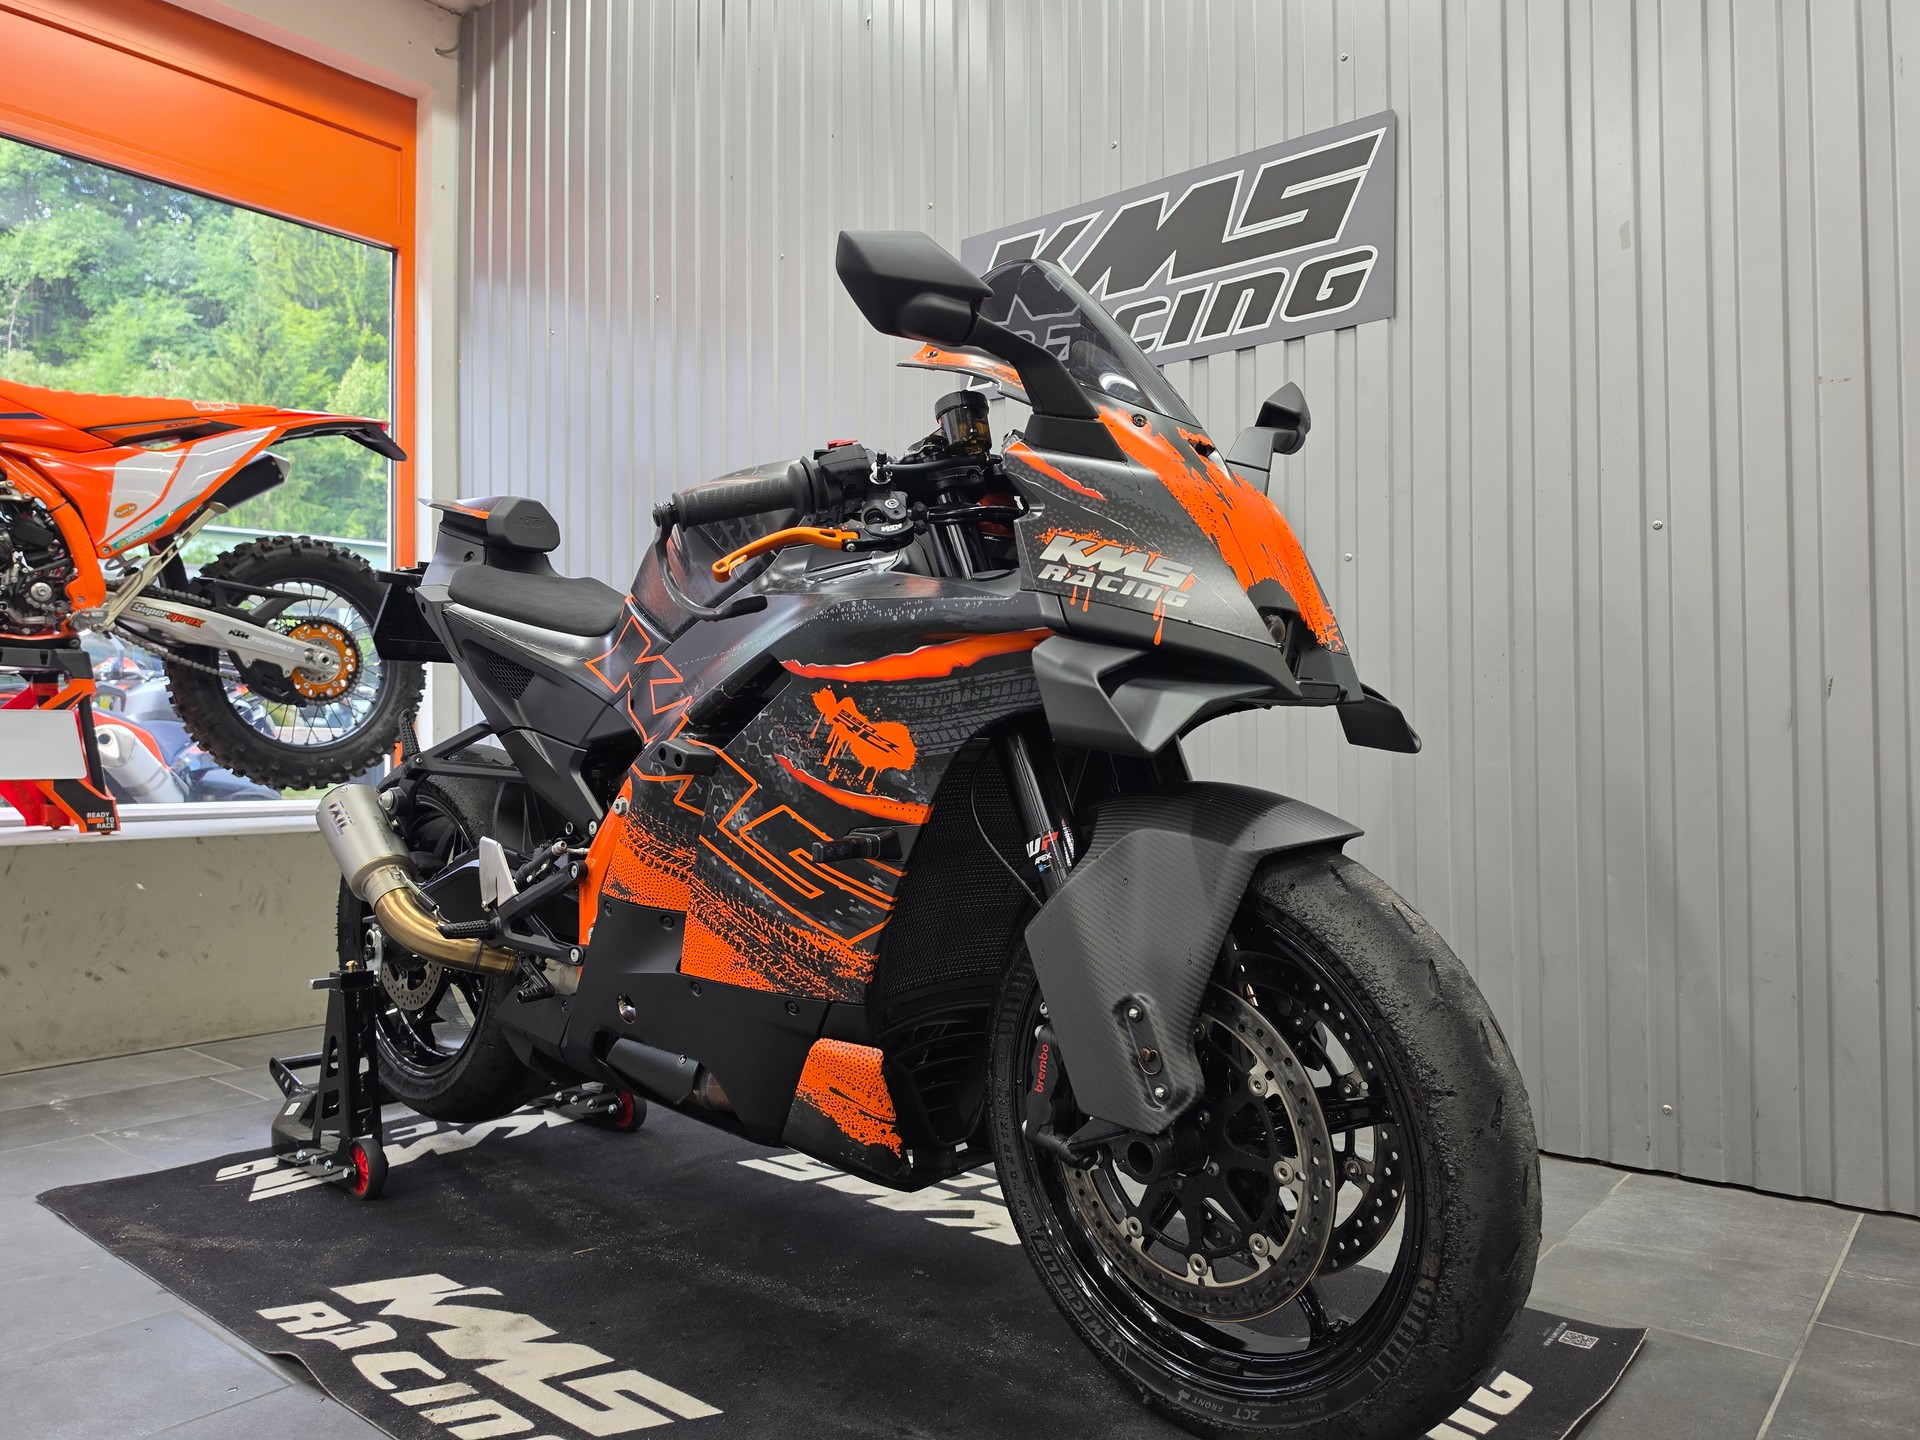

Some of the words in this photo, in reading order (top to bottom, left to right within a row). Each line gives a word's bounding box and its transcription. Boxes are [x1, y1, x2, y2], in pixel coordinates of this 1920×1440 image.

[985, 126, 1388, 322] KMS
[125, 522, 158, 544] MOTOREX
[1039, 534, 1194, 588] KMS
[1037, 563, 1191, 608] RACING
[228, 629, 250, 640] KTM
[250, 636, 296, 653] POWERPARTS
[1034, 1043, 1049, 1093] brembo
[1034, 1235, 1106, 1337] MICHELIN
[331, 1273, 724, 1437] KMS
[1191, 1396, 1225, 1413] FRONT
[1232, 1407, 1261, 1422] 2CT
